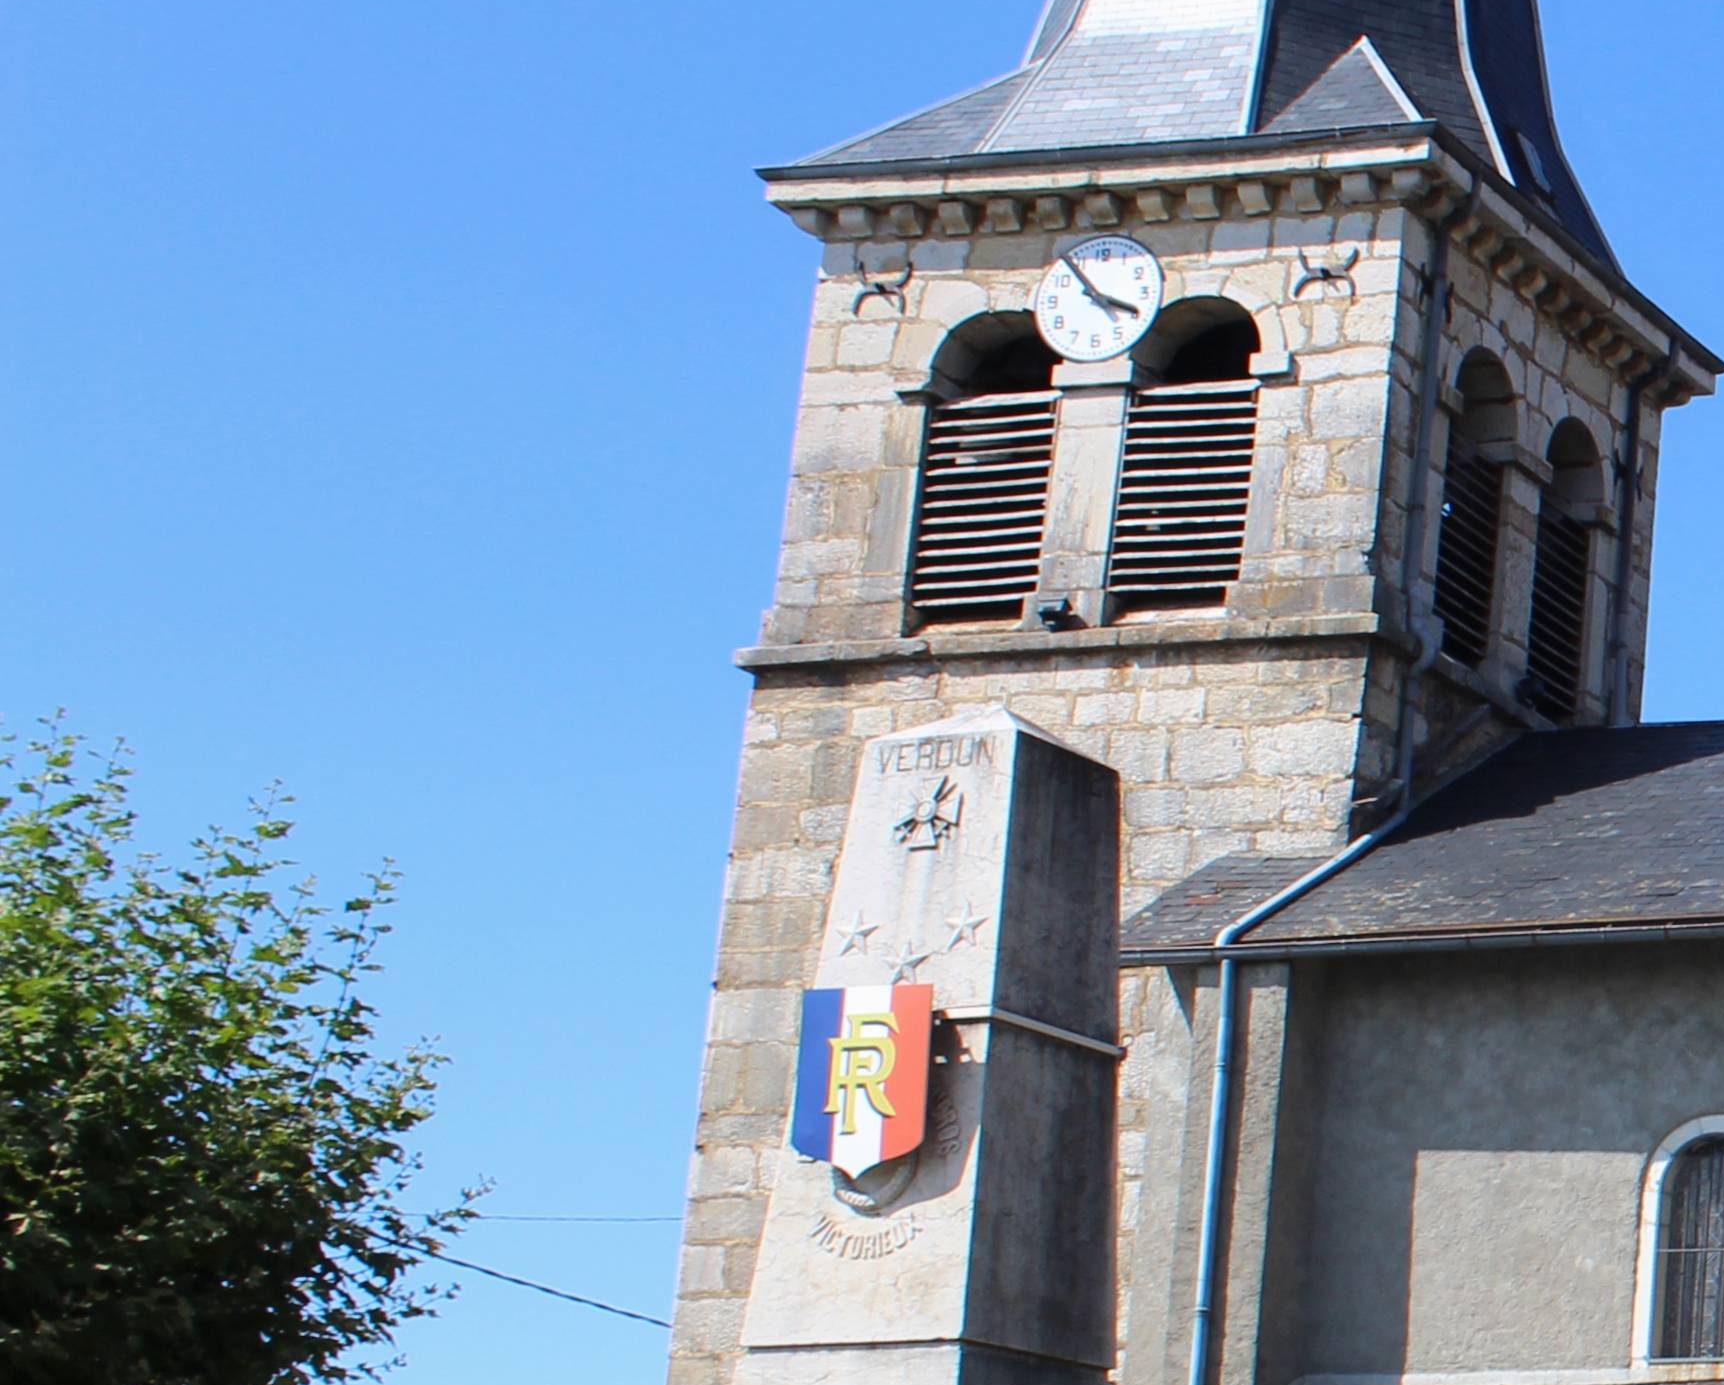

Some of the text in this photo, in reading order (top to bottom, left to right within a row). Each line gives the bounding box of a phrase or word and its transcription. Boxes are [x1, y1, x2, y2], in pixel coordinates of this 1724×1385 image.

[1096, 248, 1111, 262] 12
[1134, 267, 1144, 280] 2
[1054, 274, 1070, 288] 10
[1139, 286, 1149, 300] 3
[1047, 296, 1057, 309] 9
[1054, 315, 1064, 329] 8
[1070, 330, 1079, 345] 7
[1112, 326, 1123, 340] 5
[1090, 334, 1100, 348] 6
[879, 734, 997, 773] VERDUN
[806, 1213, 923, 1260] VICTORIEUX
